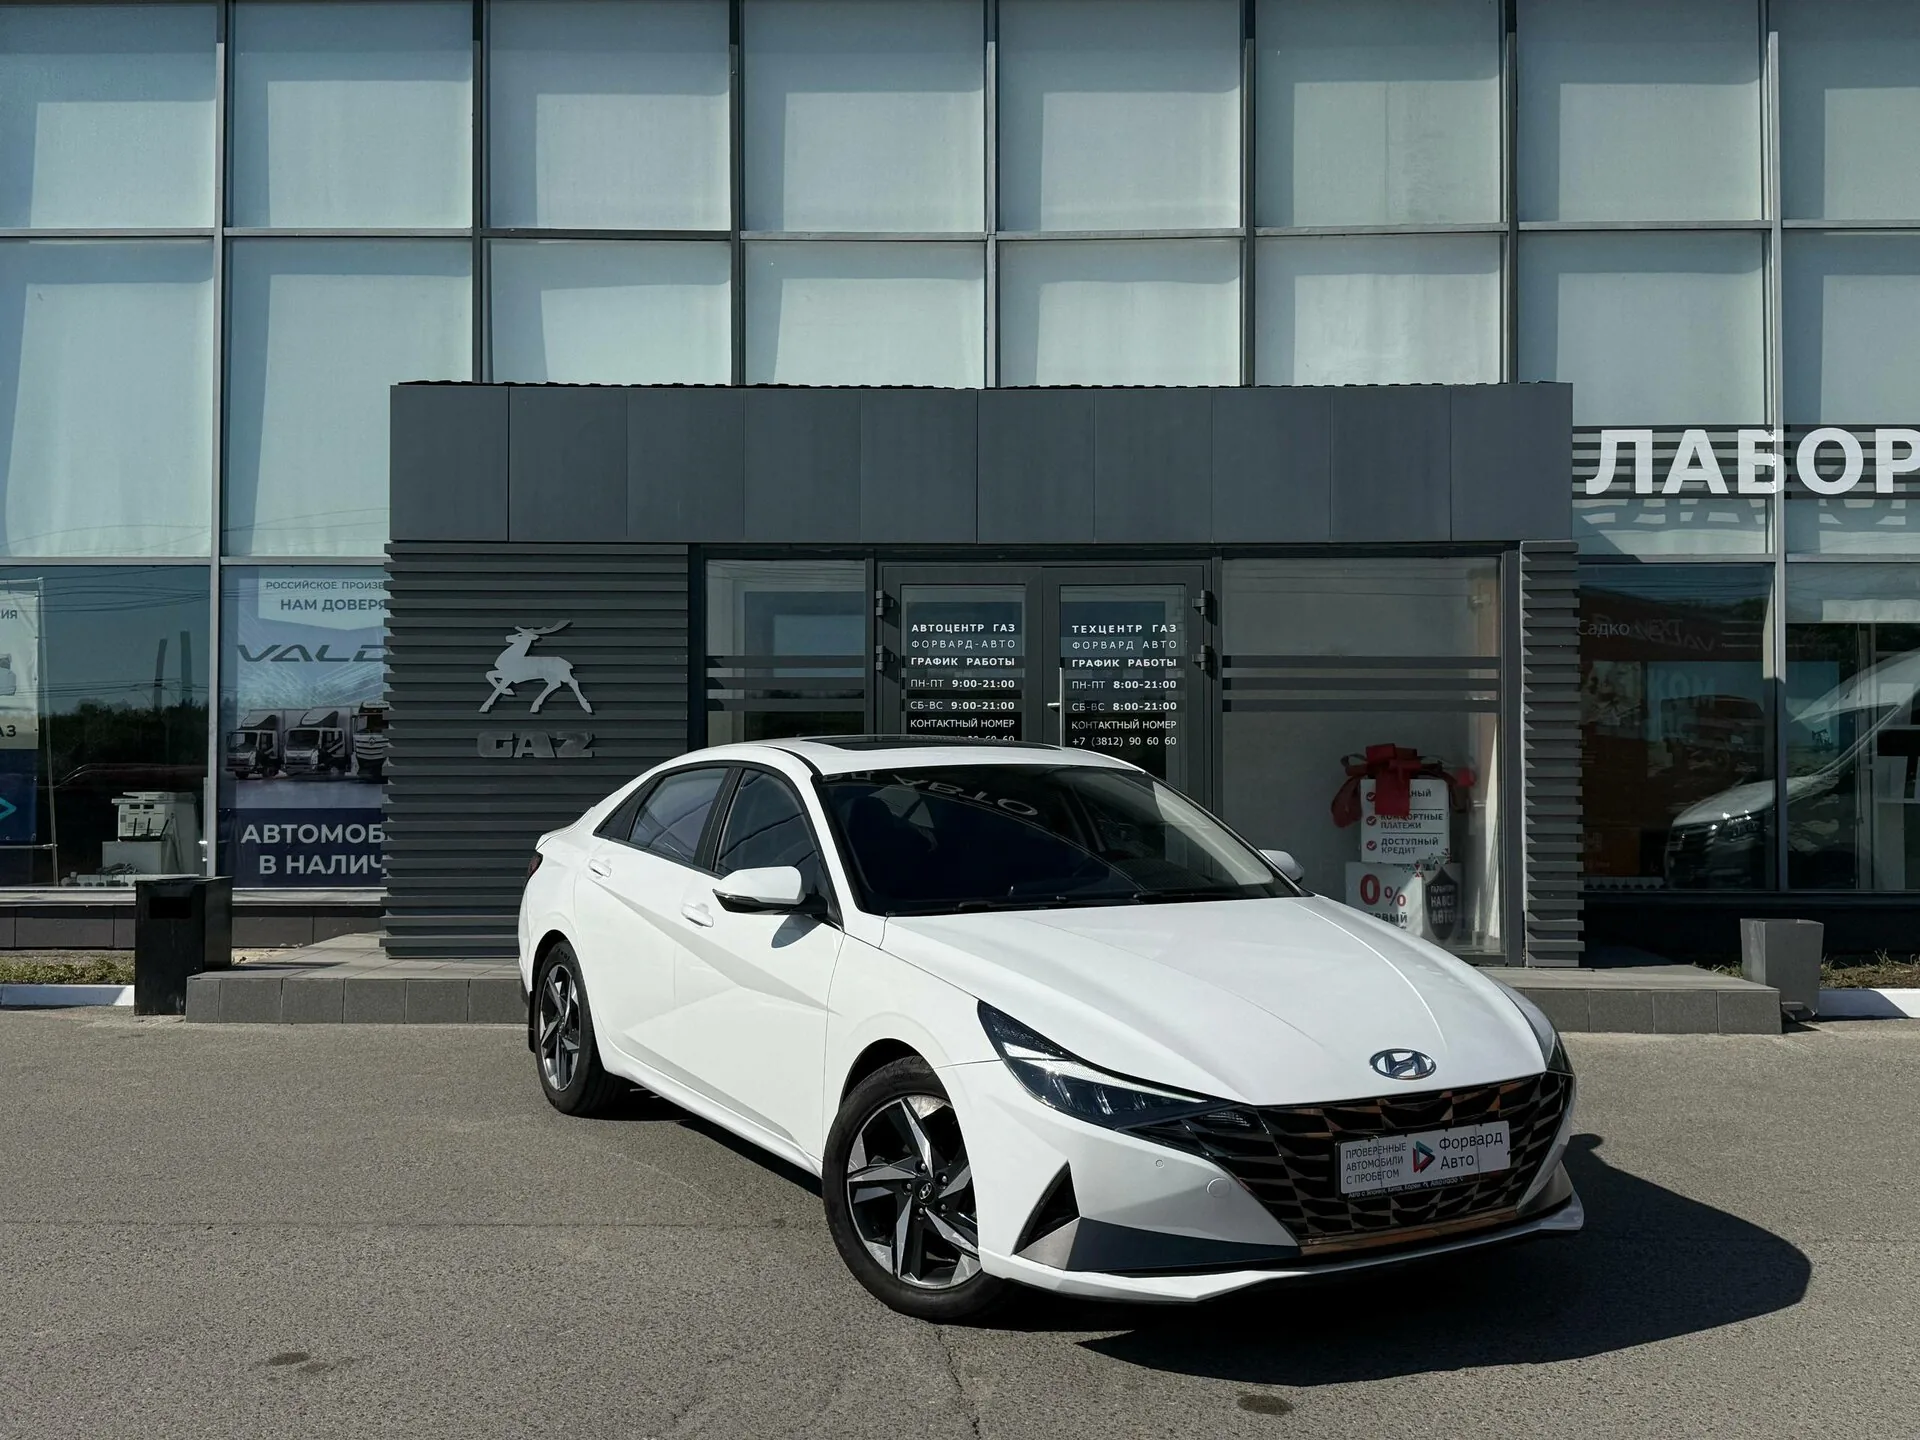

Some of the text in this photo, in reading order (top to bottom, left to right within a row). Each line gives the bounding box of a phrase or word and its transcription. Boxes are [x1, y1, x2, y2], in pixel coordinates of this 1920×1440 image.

[1586, 427, 1920, 496] ЛАБОР
[266, 580, 337, 590] РОССИЙСКОЕ
[280, 599, 318, 610] НАМ
[911, 623, 1015, 634] АВТОЦЕНТР ГАЗ
[1072, 624, 1177, 635] ТЕХЦЕНТР ГАЗ
[911, 639, 1016, 650] ФОРВАРД-АВТО
[1072, 640, 1177, 651] ФОРВАРД АВТО
[911, 658, 1015, 666] ГРАФИК РАБОТЫ
[1072, 658, 1177, 668] ГРАФИК РАБОТЫ
[910, 679, 1015, 688] ПН-ПТ 9:00-21:00
[1072, 680, 1177, 689] ПН-ПТ 8:00-21:00
[910, 701, 1015, 710] СБ-ВС 9:00-21:00
[1072, 702, 1177, 711] СБ-ВС 8:00-21:00
[910, 718, 1015, 728] КОНТАКТНЫЙ НОМЕР
[1072, 719, 1177, 730] КОНТАКТНЫЙ НОМЕР
[477, 731, 593, 757] GAZ
[1072, 736, 1177, 747] +7 (3812) 90 60 60
[241, 824, 385, 844] АВТОМОБ
[1381, 837, 1439, 846] ДОСТУПНЫЙ
[1381, 847, 1416, 855] КРЕДИТ
[260, 855, 387, 874] В НАЛИЧ
[1439, 1131, 1503, 1151] Форвард
[1345, 1142, 1407, 1159] ПРОВЕРЕННЫЕ
[1346, 1155, 1404, 1172] АВТОМОБИЛИ
[1440, 1154, 1474, 1170] Авто
[1354, 1169, 1399, 1183] ПРОБЕГОМ
